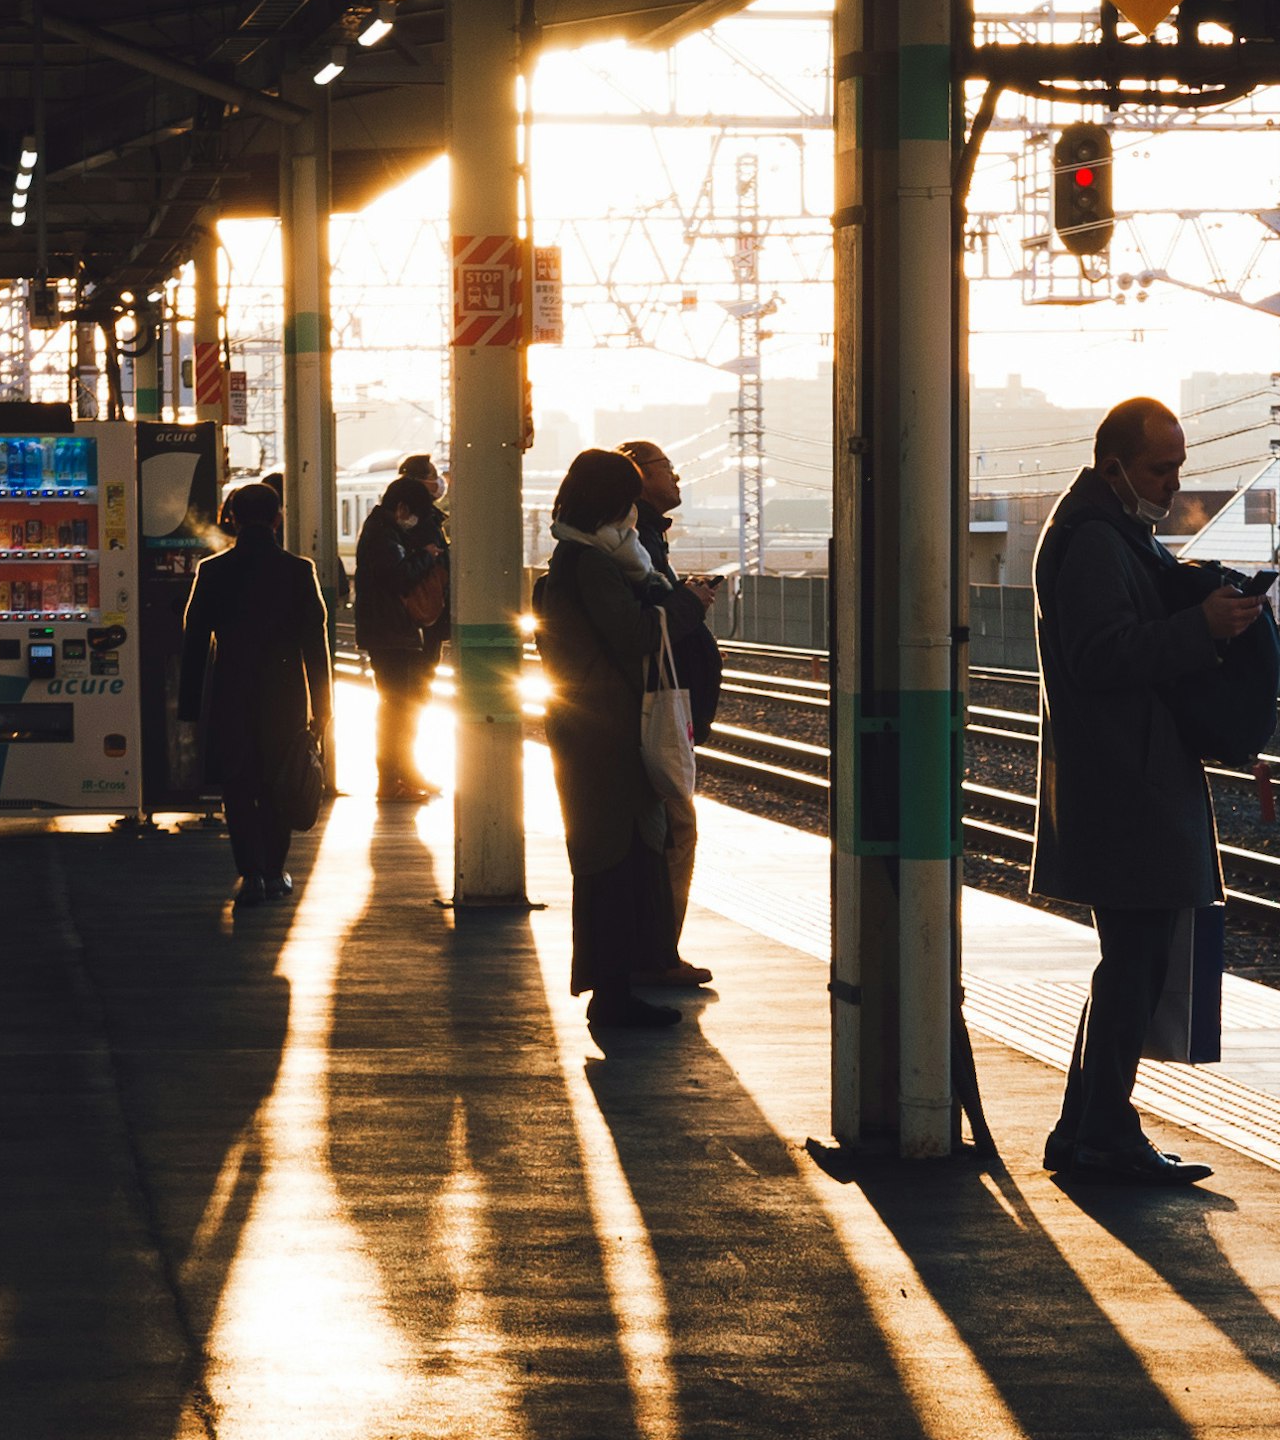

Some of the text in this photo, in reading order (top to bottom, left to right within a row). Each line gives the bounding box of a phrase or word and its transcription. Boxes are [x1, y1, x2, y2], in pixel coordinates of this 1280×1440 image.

[465, 271, 500, 283] STOP
[156, 432, 197, 442] acure
[47, 678, 125, 695] acure
[81, 779, 126, 790] JR-Cross
